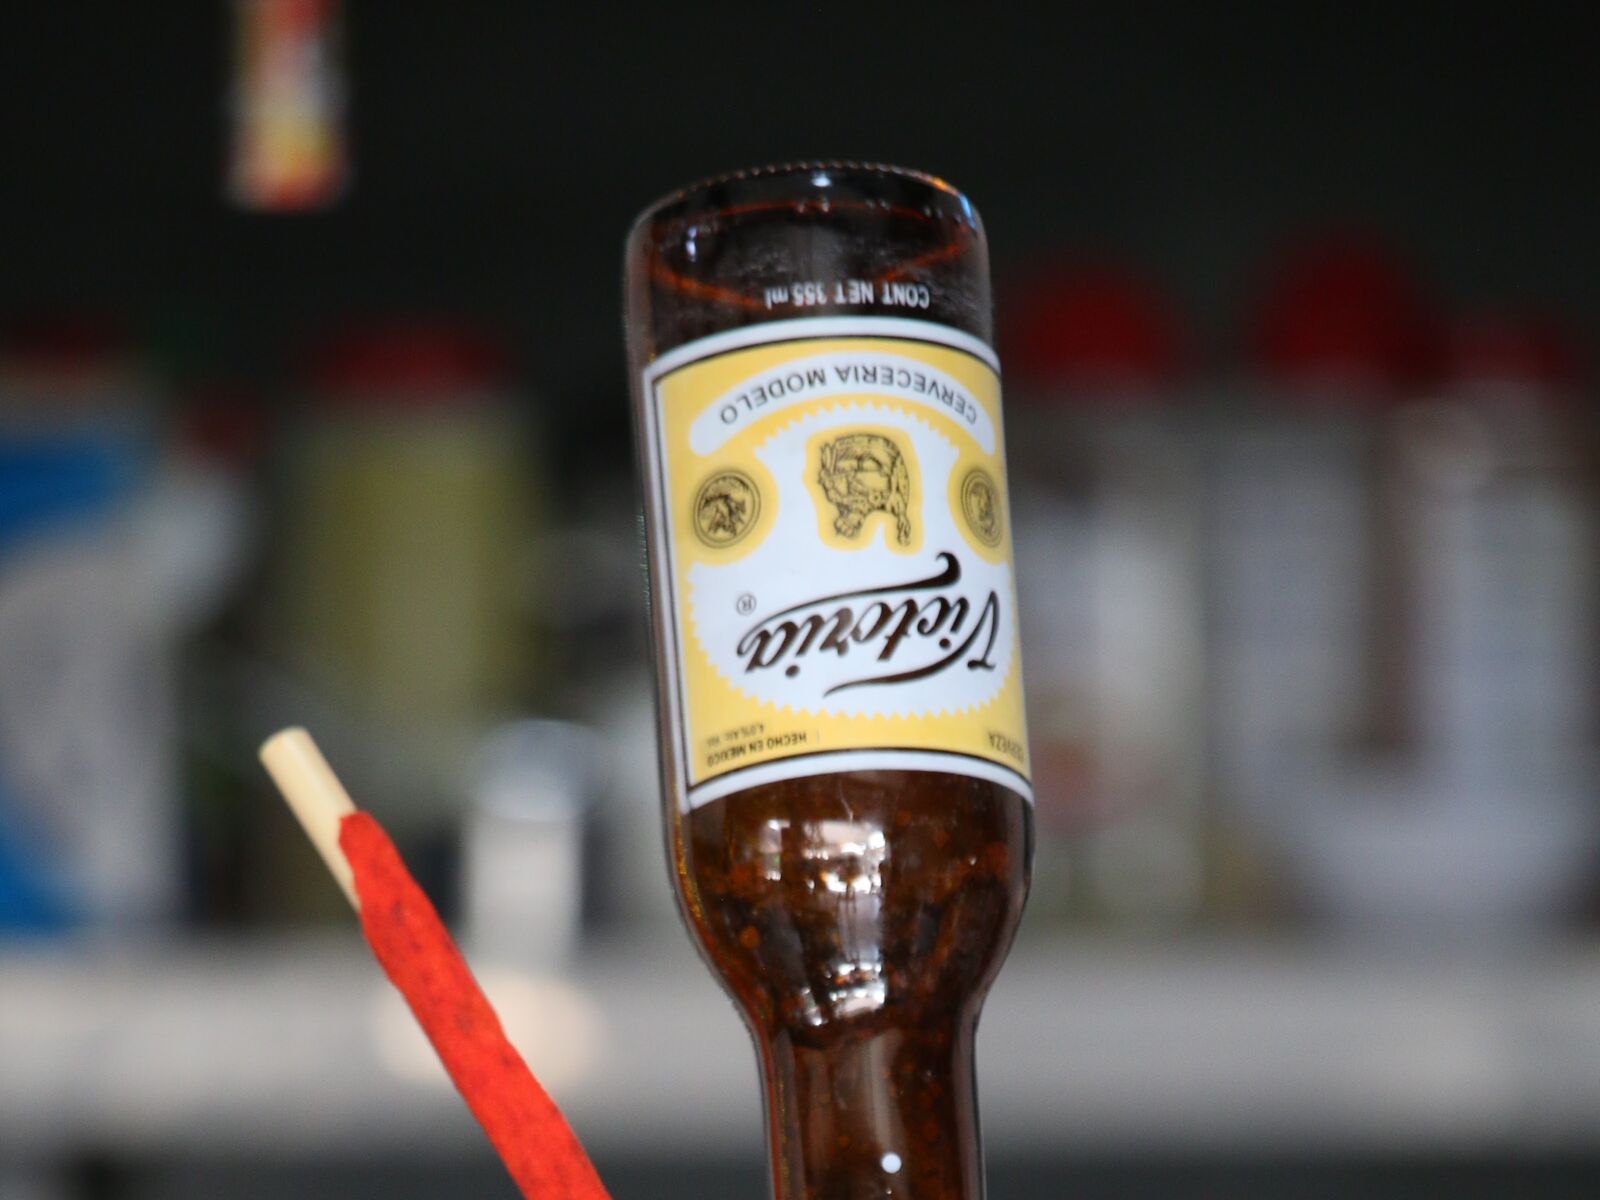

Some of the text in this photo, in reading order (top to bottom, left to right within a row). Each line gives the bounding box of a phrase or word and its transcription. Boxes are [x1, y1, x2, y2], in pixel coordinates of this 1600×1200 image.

[765, 279, 930, 310] CONT NET 355 ml
[720, 365, 977, 424] CERVECERIA MODELO
[737, 552, 1000, 698] Victoria
[749, 739, 764, 752] EN
[767, 732, 807, 749] HECHO
